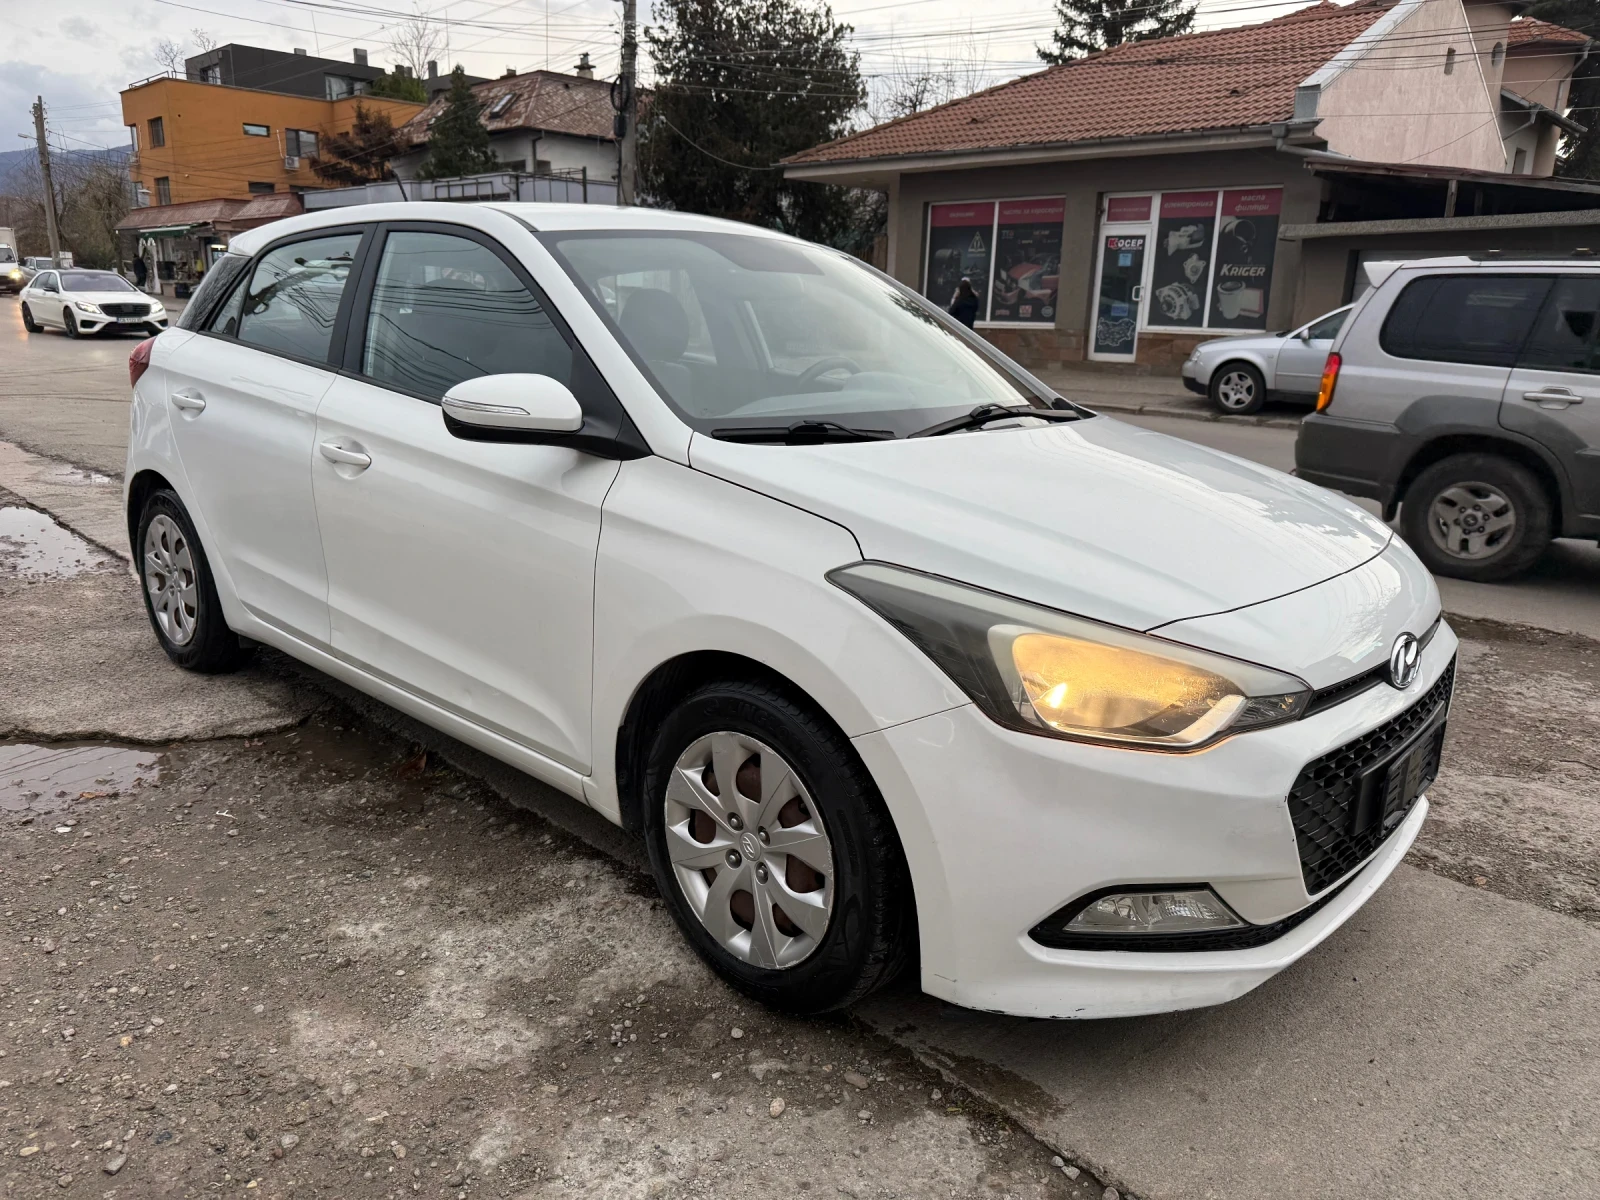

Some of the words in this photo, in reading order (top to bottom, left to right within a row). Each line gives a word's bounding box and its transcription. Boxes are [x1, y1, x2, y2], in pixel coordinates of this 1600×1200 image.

[1164, 201, 1214, 209] електроника
[1234, 203, 1269, 212] филтри
[1108, 238, 1143, 249] КОСЕР
[1220, 264, 1266, 277] KRIGER
